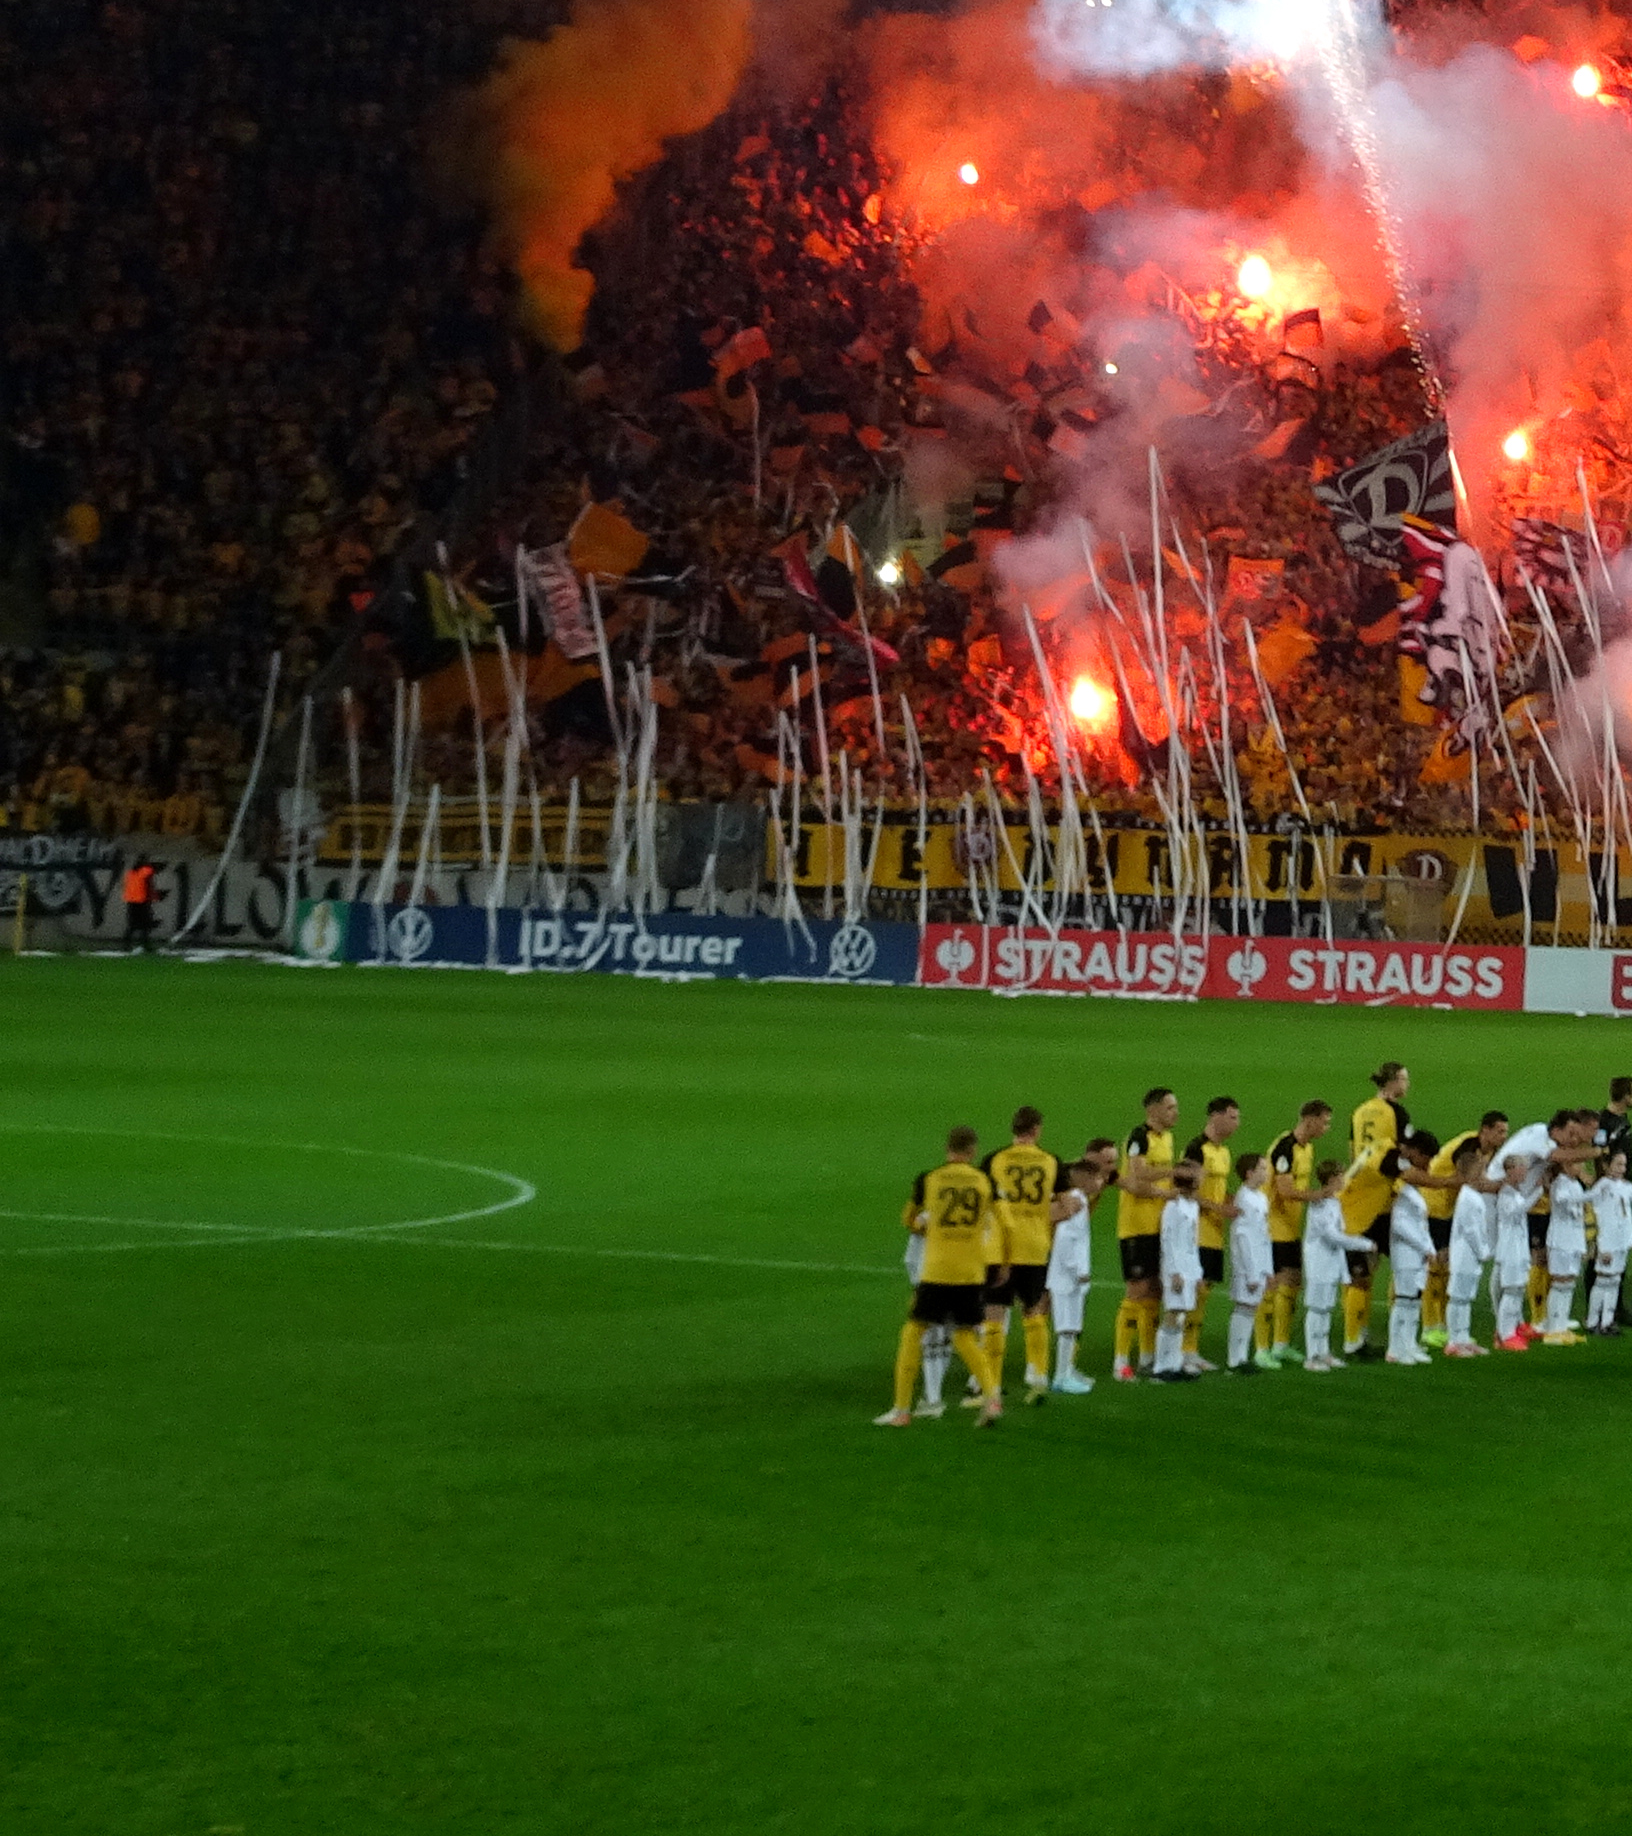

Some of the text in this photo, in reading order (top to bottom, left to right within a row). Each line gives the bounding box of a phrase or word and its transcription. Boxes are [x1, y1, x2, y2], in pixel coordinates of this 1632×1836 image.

[606, 923, 744, 965] Tourer
[993, 940, 1207, 994] STRAUSS
[1287, 953, 1504, 999] STRAUSS
[1004, 1165, 1047, 1206] 33
[937, 1186, 981, 1228] 29
